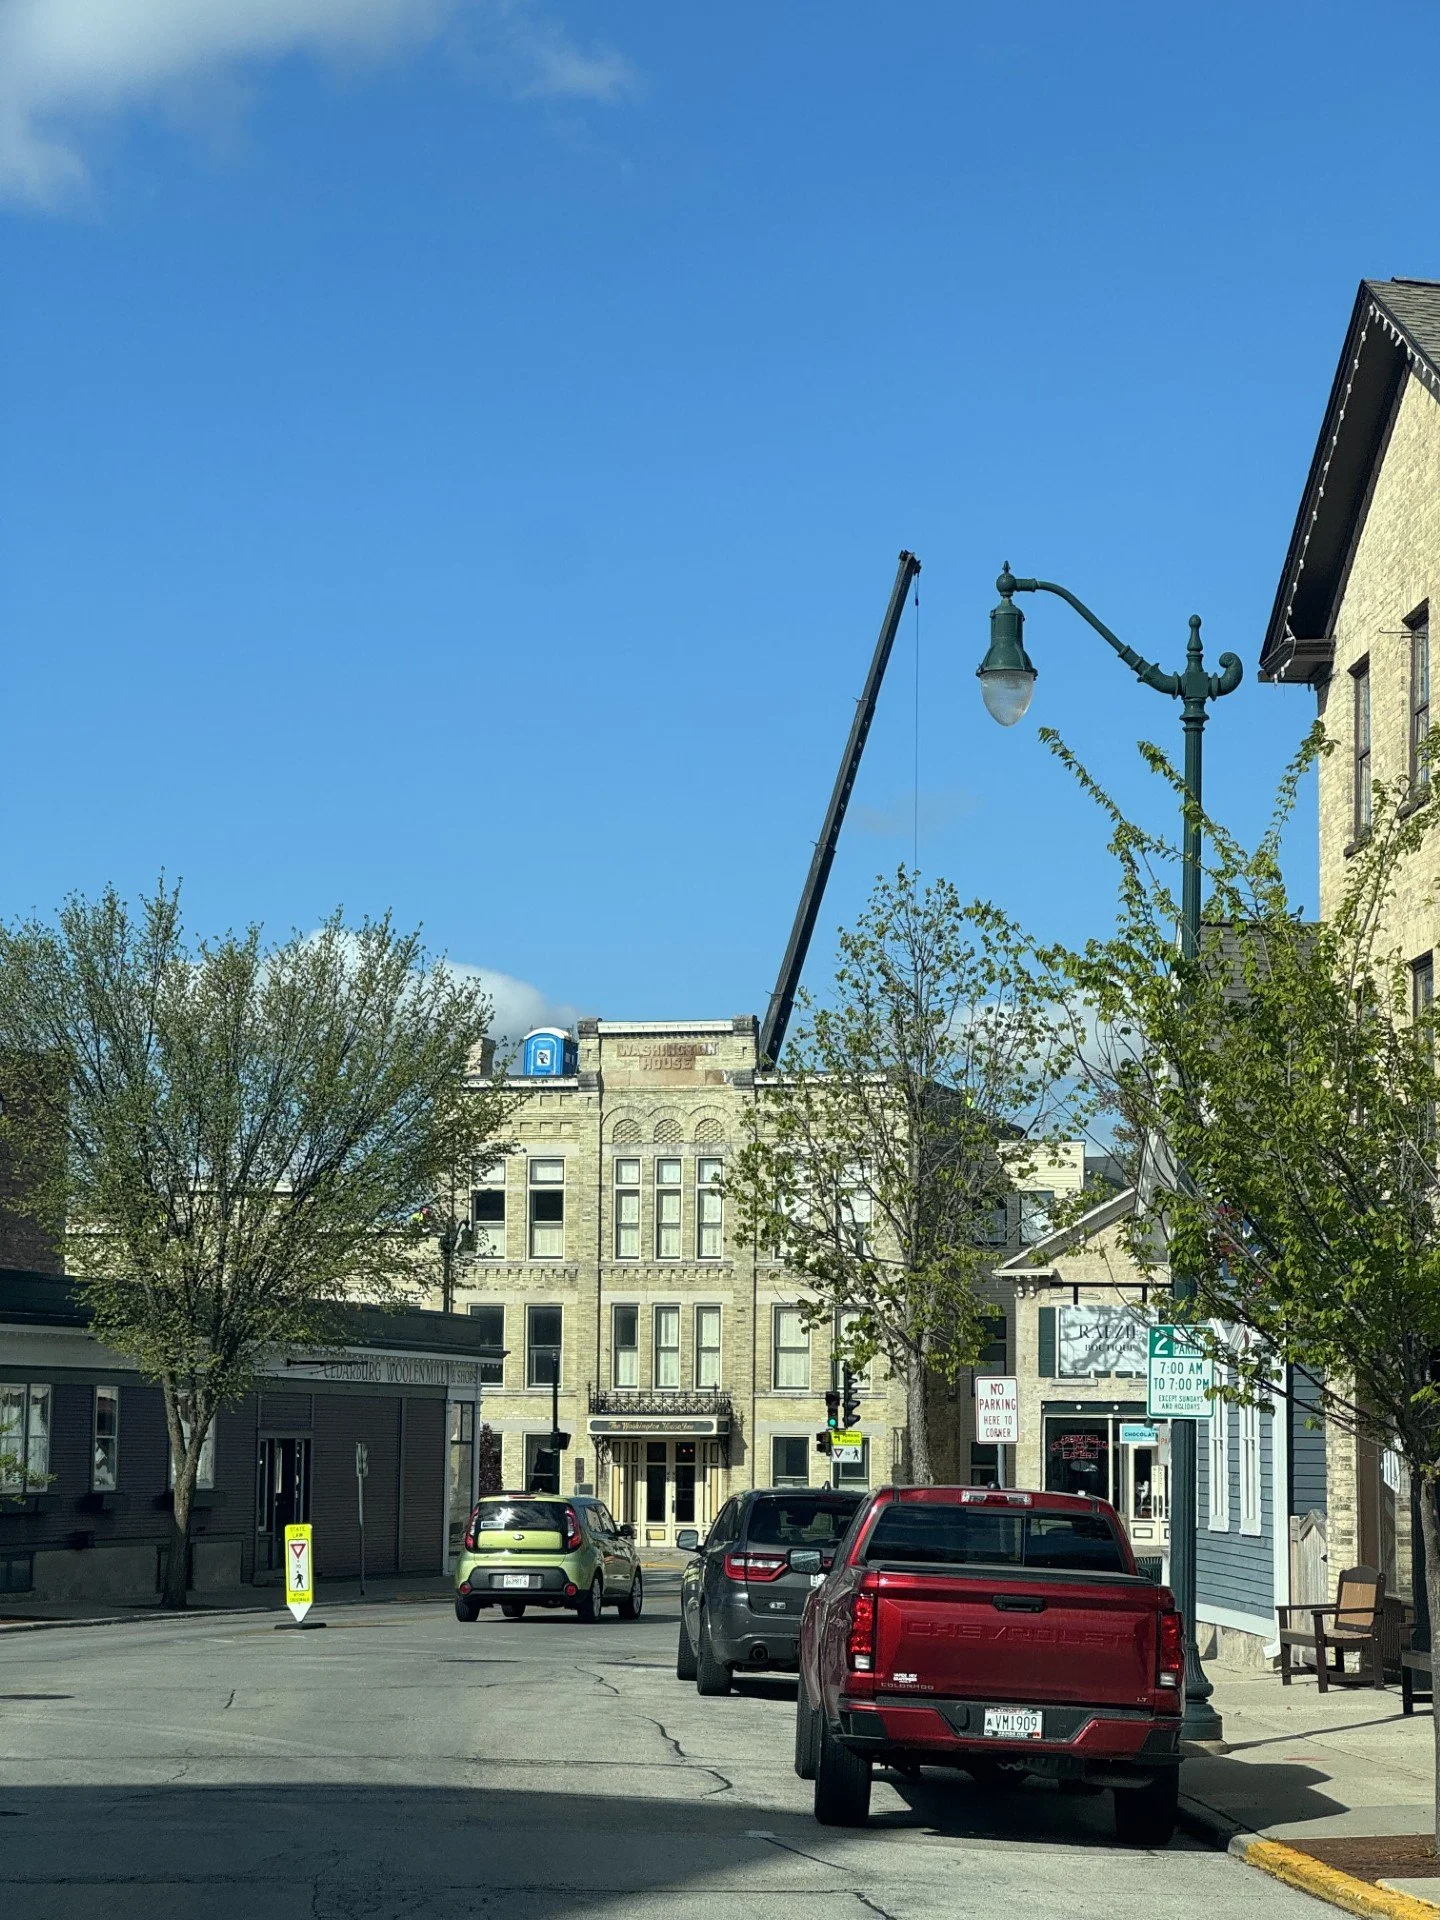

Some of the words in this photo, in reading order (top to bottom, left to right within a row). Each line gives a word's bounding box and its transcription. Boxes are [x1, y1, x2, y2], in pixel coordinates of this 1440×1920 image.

[618, 1042, 718, 1056] WASHINGTON
[643, 1057, 692, 1070] HOUSE
[1154, 1329, 1169, 1355] 2
[1085, 1344, 1134, 1354] BOUTIQUE
[1174, 1342, 1210, 1356] PARKIN
[386, 1362, 424, 1383] WOOLEN
[425, 1364, 446, 1384] MILL
[1160, 1361, 1184, 1375] 7:00
[1189, 1362, 1203, 1375] AM
[457, 1369, 477, 1384] SHOPS
[990, 1383, 1004, 1396] NO
[1153, 1377, 1165, 1390] TO
[1169, 1377, 1192, 1390] 7:00
[1196, 1378, 1209, 1390] PM
[979, 1398, 1016, 1411] PARKING
[1158, 1394, 1178, 1402] EXCEPT
[622, 1421, 660, 1431] Washington
[983, 1415, 1001, 1425] HERE
[1004, 1415, 1013, 1425] TO
[985, 1427, 1012, 1438] CORNER
[881, 1682, 934, 1690] COLORADO
